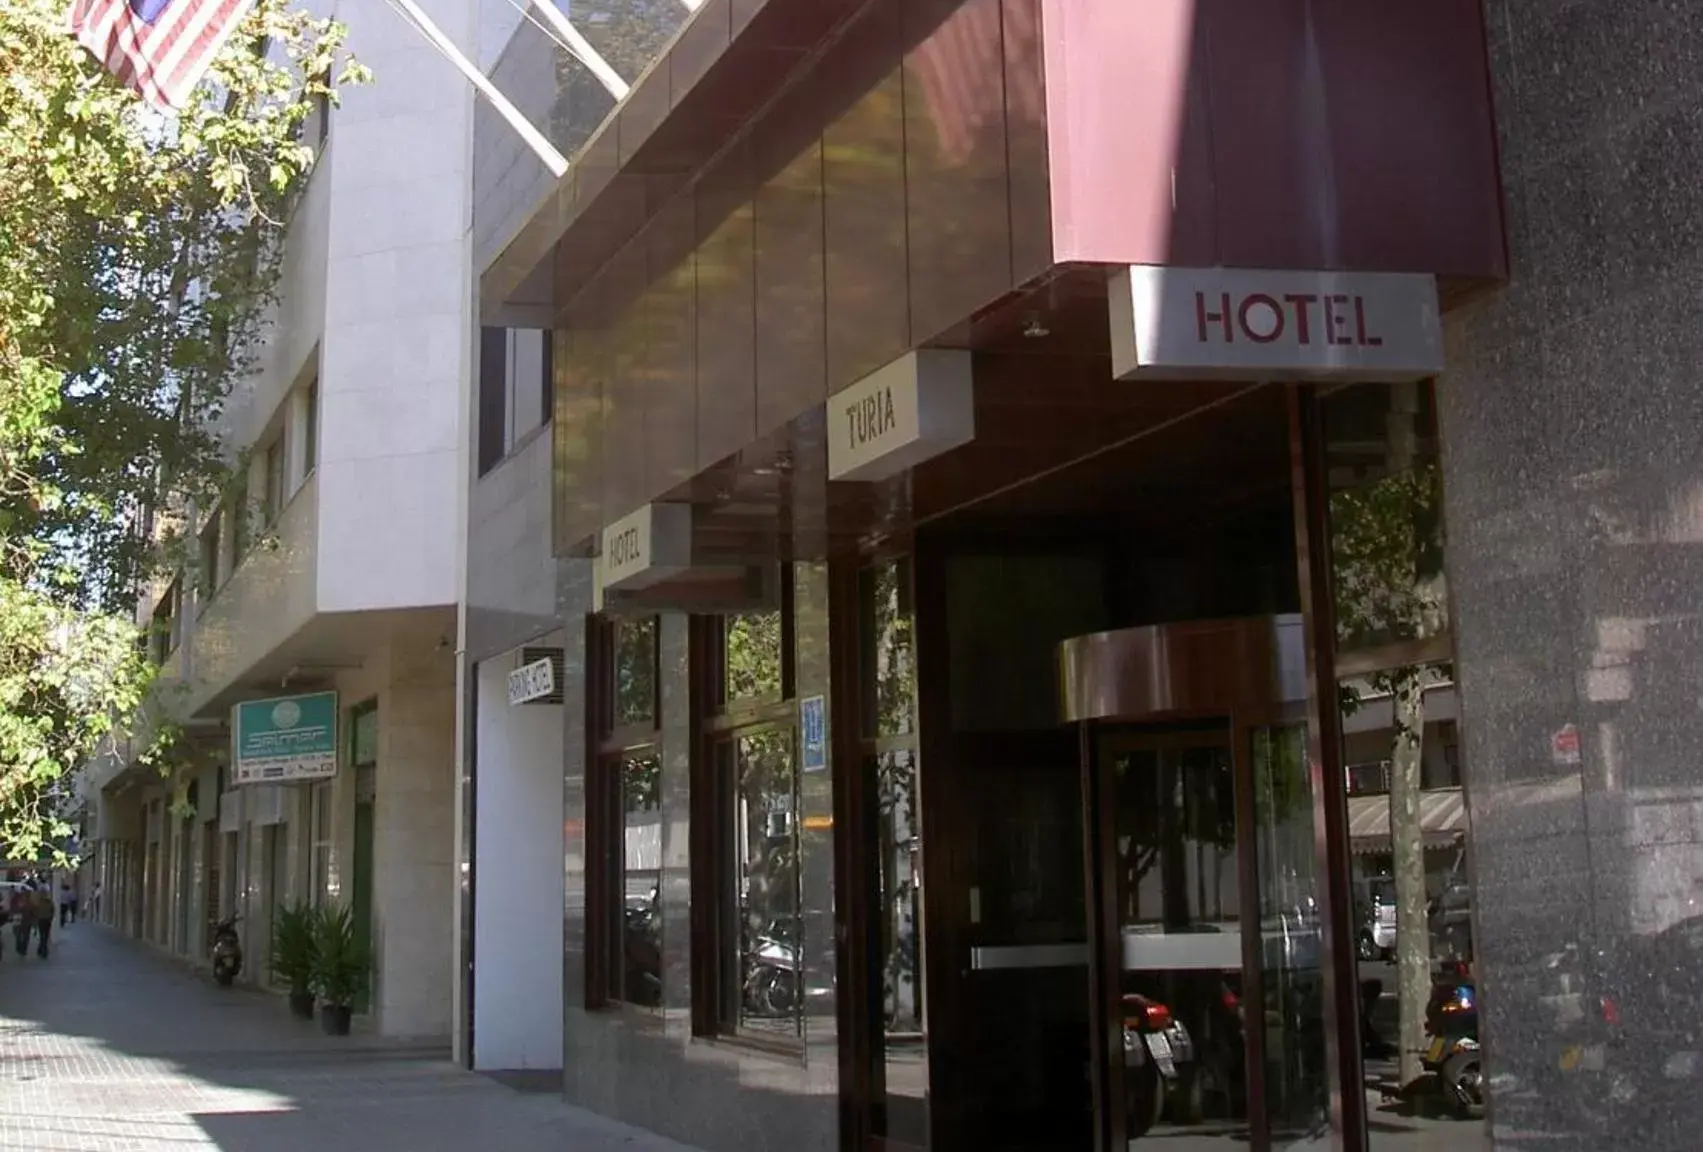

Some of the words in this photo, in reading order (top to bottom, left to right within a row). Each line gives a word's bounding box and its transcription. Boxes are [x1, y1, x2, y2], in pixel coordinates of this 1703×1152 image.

[1195, 291, 1383, 346] HOTEL
[846, 385, 896, 450] TURIA
[609, 528, 640, 570] HOTEL
